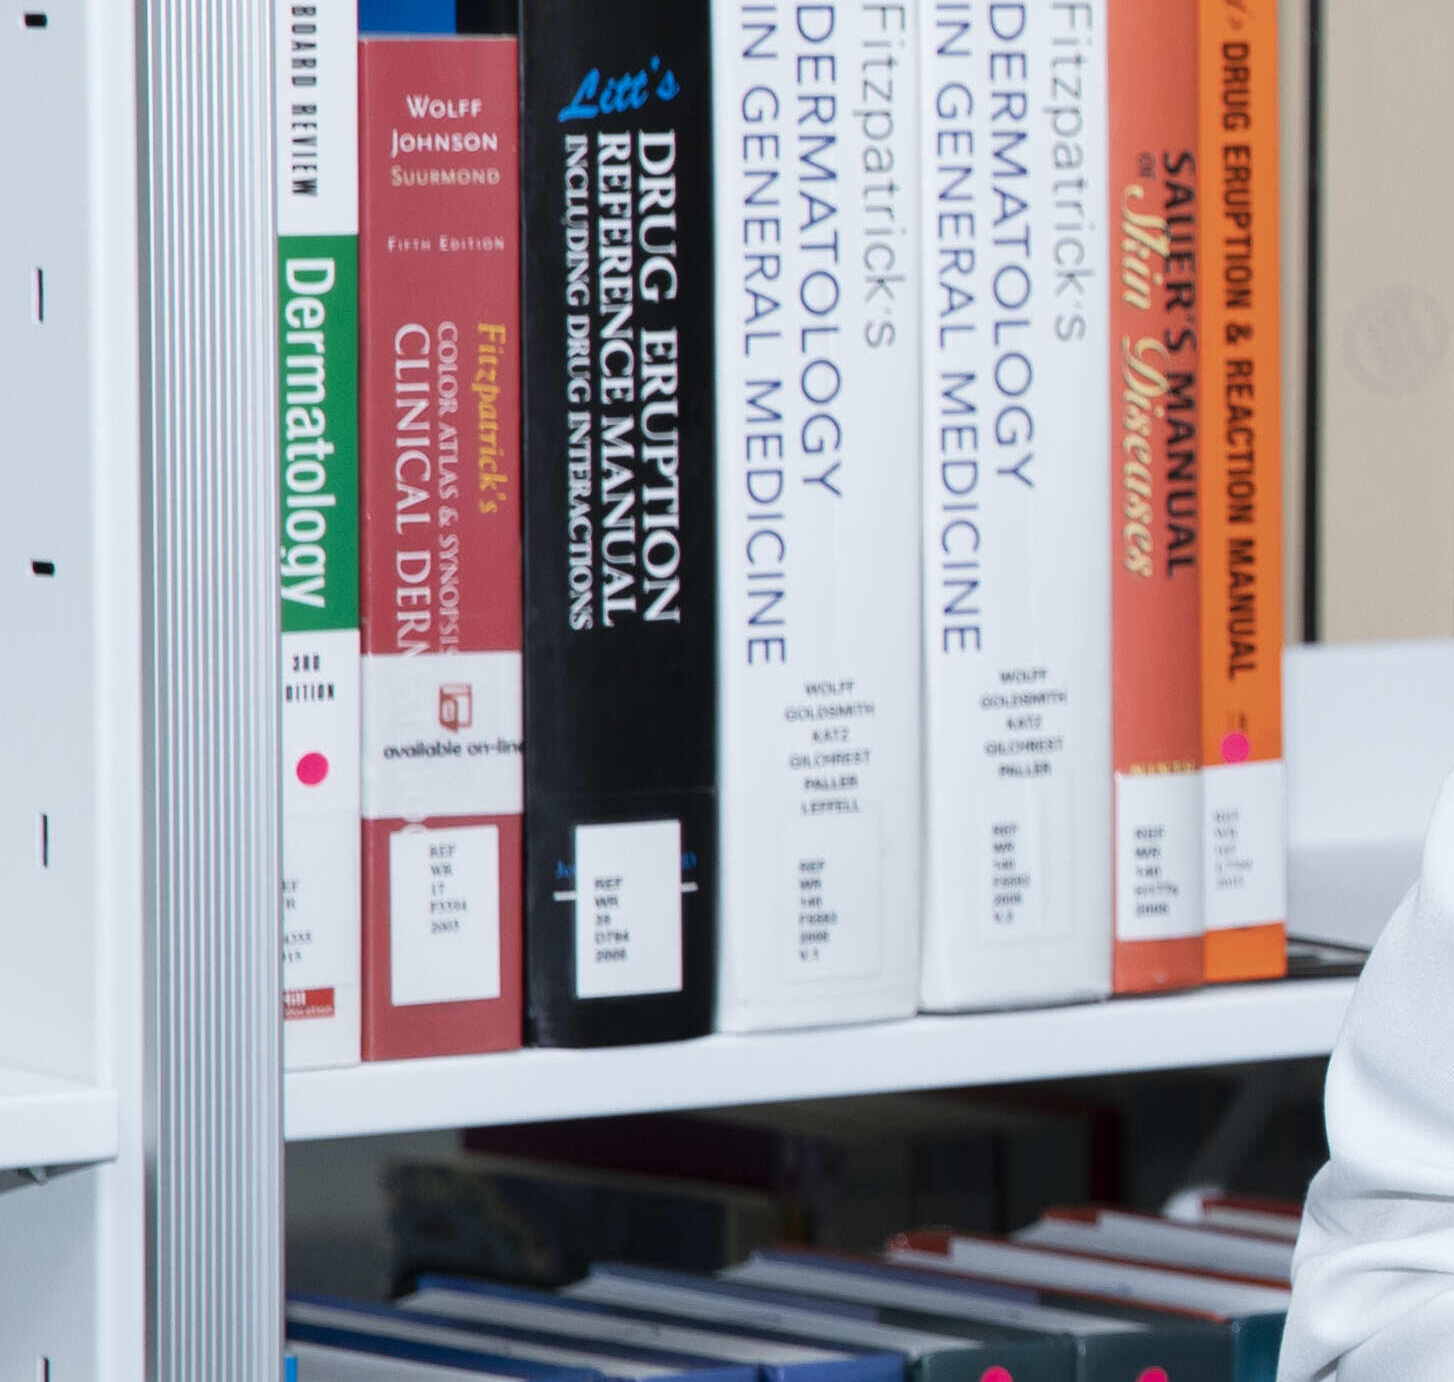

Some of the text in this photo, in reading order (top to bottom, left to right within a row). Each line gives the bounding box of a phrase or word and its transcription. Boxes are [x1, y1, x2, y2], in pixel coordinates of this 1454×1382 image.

[290, 5, 318, 87] BOARD
[557, 54, 680, 122] Litt's
[1221, 40, 1250, 131] DRUG
[290, 103, 319, 197] REVIEW
[796, 4, 842, 498] DERMATOLOGY
[853, 3, 906, 351] Fitzpatrick's
[988, 1, 1035, 489] DERMATOLOGY
[1043, 1, 1094, 343] Fitzpatrick's
[1223, 146, 1253, 311] ERUPTION
[394, 323, 431, 535] CLINICAL
[437, 320, 459, 416] COLOR
[472, 322, 509, 515] Fitzpatrick's
[564, 134, 594, 631] INCLUDING DRUG INTERACTIONS
[598, 130, 637, 629] REFERENCE MANUAL
[638, 129, 681, 623] DRUG ERUPTION
[741, 4, 786, 665] IN GENERAL MEDICINE
[936, 2, 982, 654] IN GENERAL MEDICINE
[1120, 185, 1172, 578] Skin Diseases
[1163, 151, 1198, 579] SAUER'S MANUAL
[1225, 323, 1254, 346] &
[280, 258, 335, 608] Dermatology
[437, 421, 460, 500] ATLAS
[438, 506, 459, 527] &
[1226, 360, 1256, 526] REACTION
[1228, 539, 1258, 681] MANUAL
[383, 739, 463, 760] available
